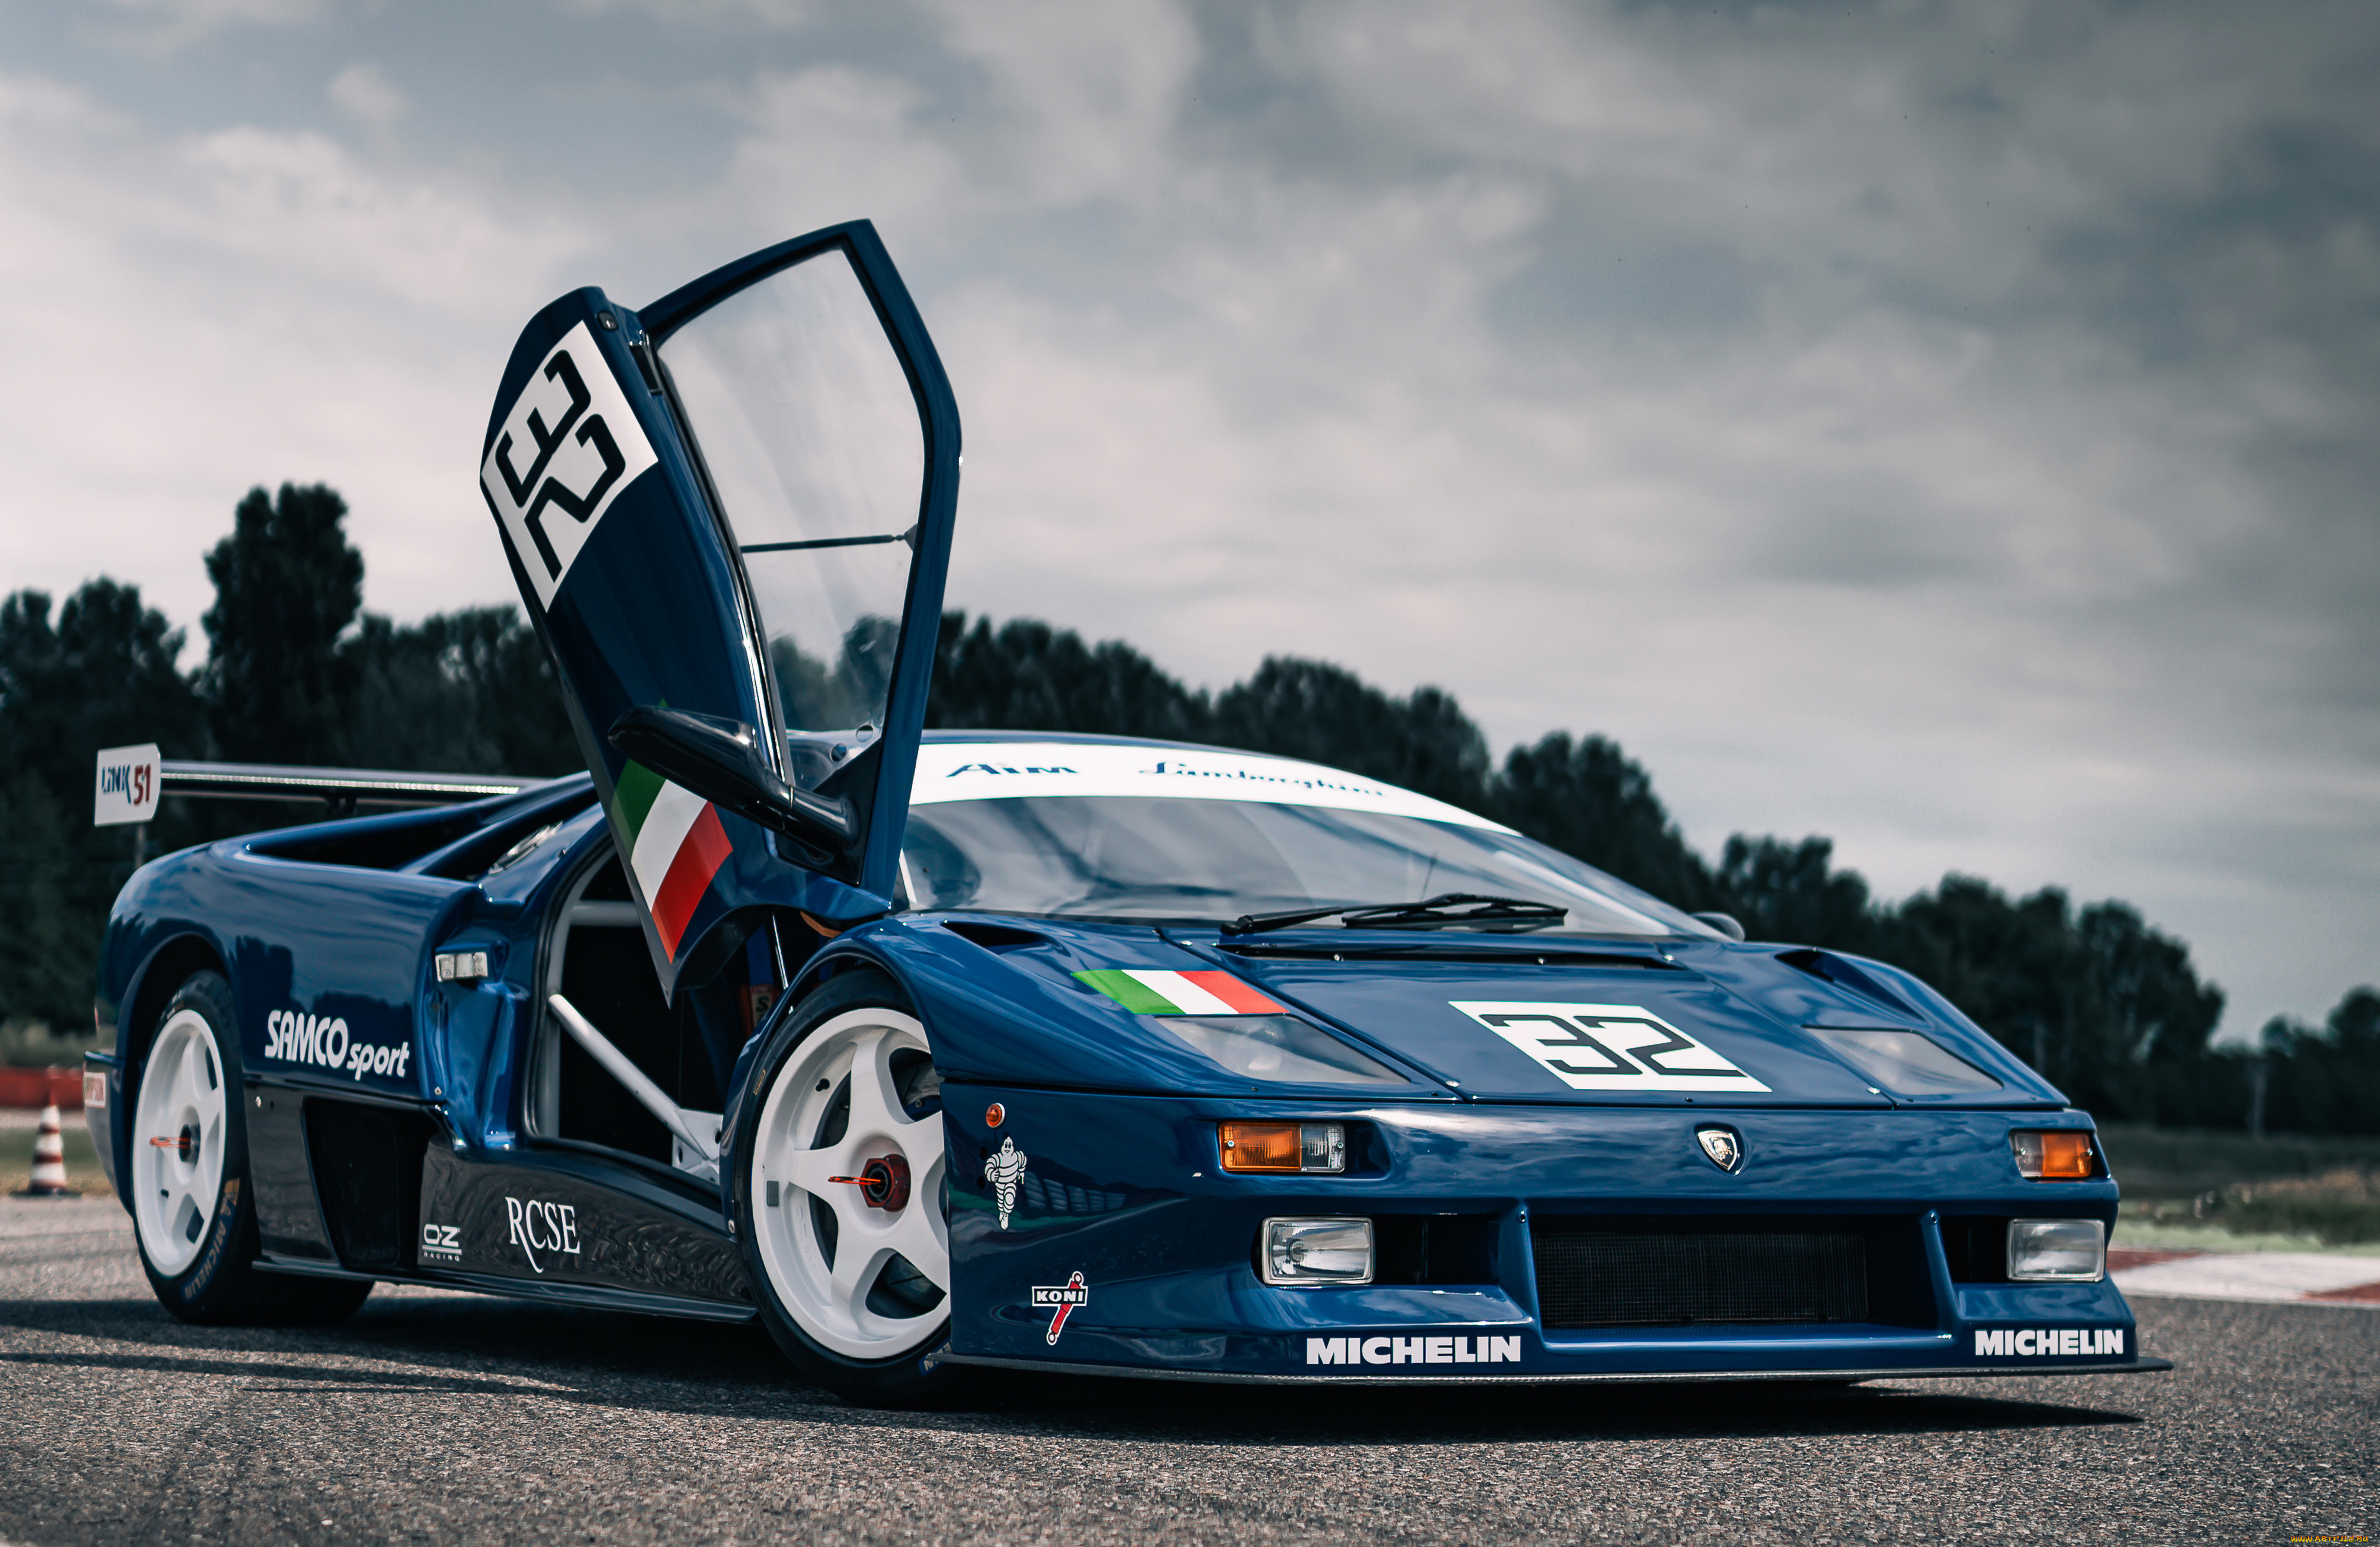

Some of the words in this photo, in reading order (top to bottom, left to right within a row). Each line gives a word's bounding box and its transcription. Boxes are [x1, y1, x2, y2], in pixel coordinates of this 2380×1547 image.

[495, 349, 626, 584] 32
[133, 763, 151, 806] 51
[1138, 760, 1385, 797] Lamborghini
[264, 1010, 349, 1069] SAMCO
[347, 1041, 410, 1081] sport
[1479, 1014, 1748, 1078] 32
[423, 1223, 461, 1248] OZ
[505, 1197, 580, 1273] RCSE
[184, 1220, 227, 1300] MICHELIN
[423, 1251, 461, 1262] RACING
[1036, 1291, 1083, 1302] KONI
[1307, 1336, 1521, 1364] MICHELIN
[1975, 1330, 2124, 1355] MICHELIN
